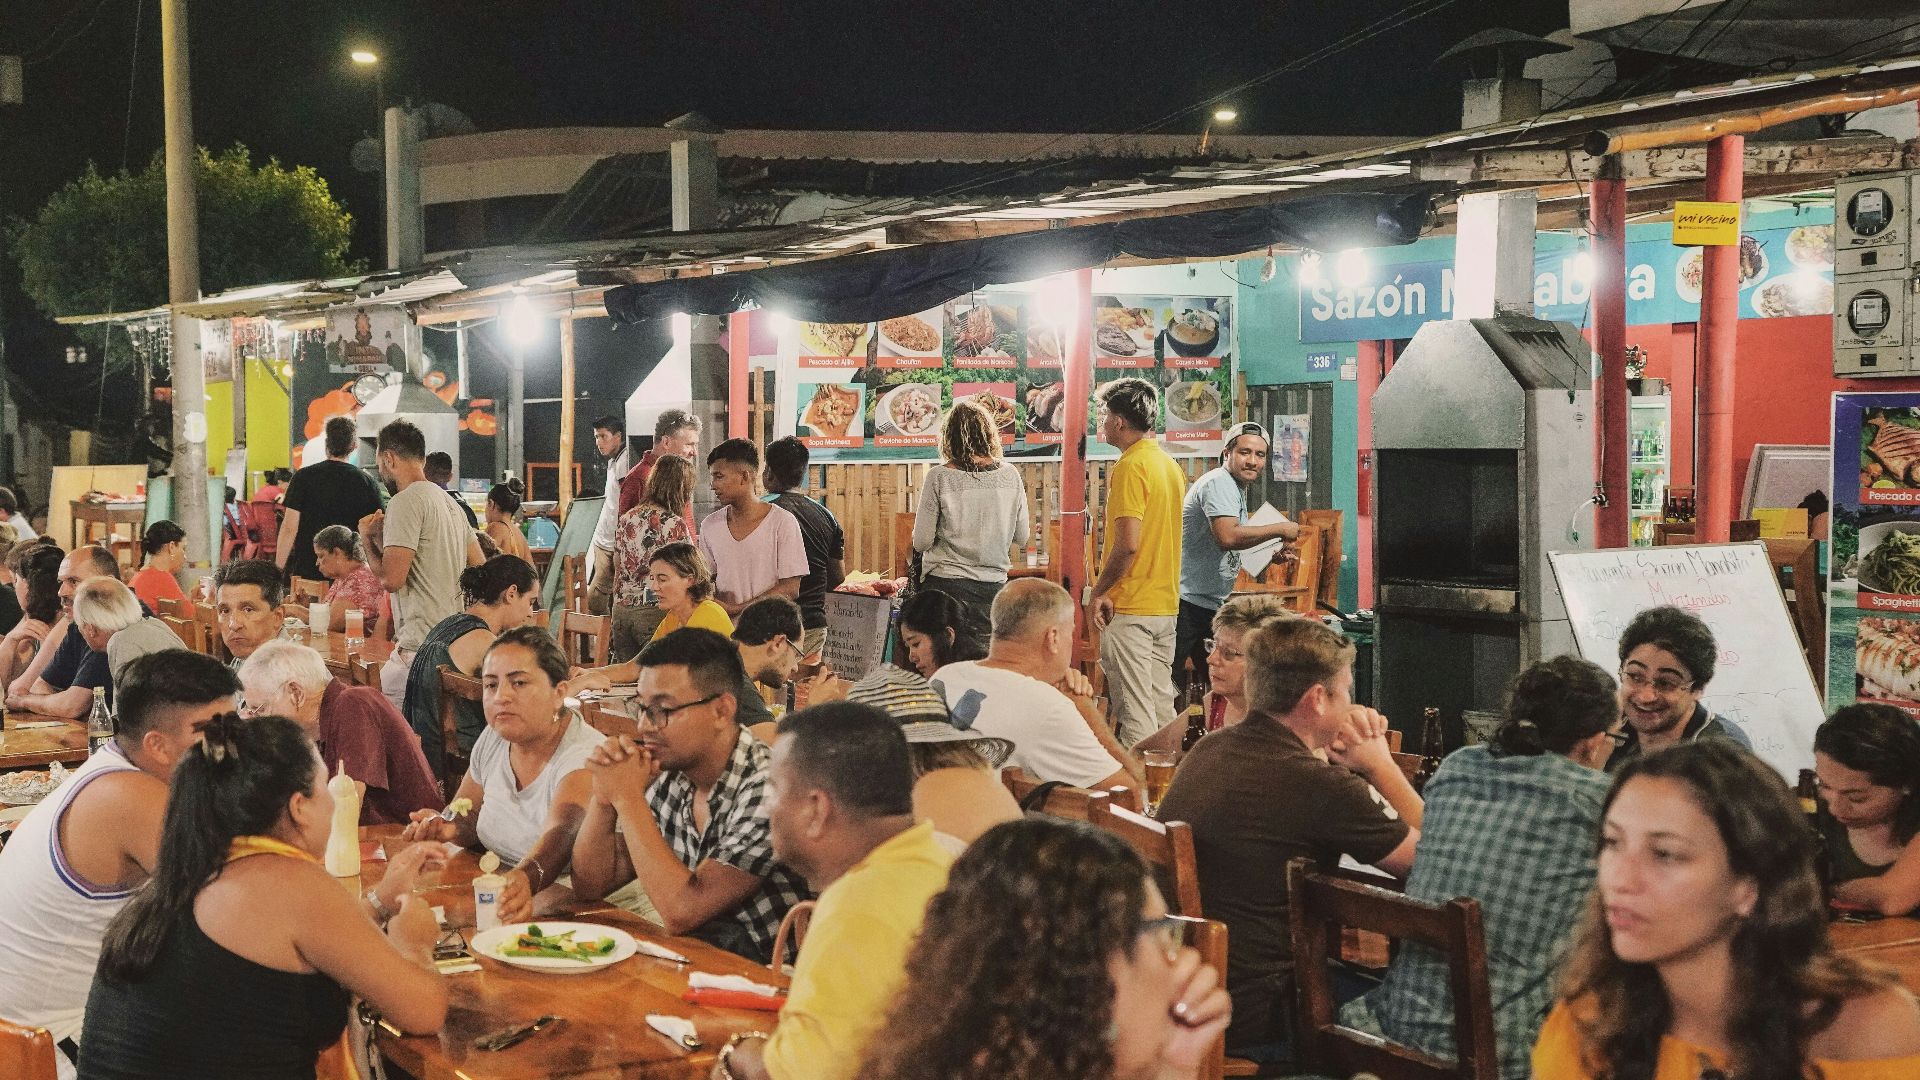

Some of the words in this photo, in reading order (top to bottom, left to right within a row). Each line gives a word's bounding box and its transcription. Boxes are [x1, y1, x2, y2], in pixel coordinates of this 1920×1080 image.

[1699, 214, 1736, 225] vecino
[1311, 273, 1426, 322] Sazón
[1313, 355, 1331, 369] 336
[808, 439, 824, 447] Sopa
[1869, 490, 1912, 501] Pescado
